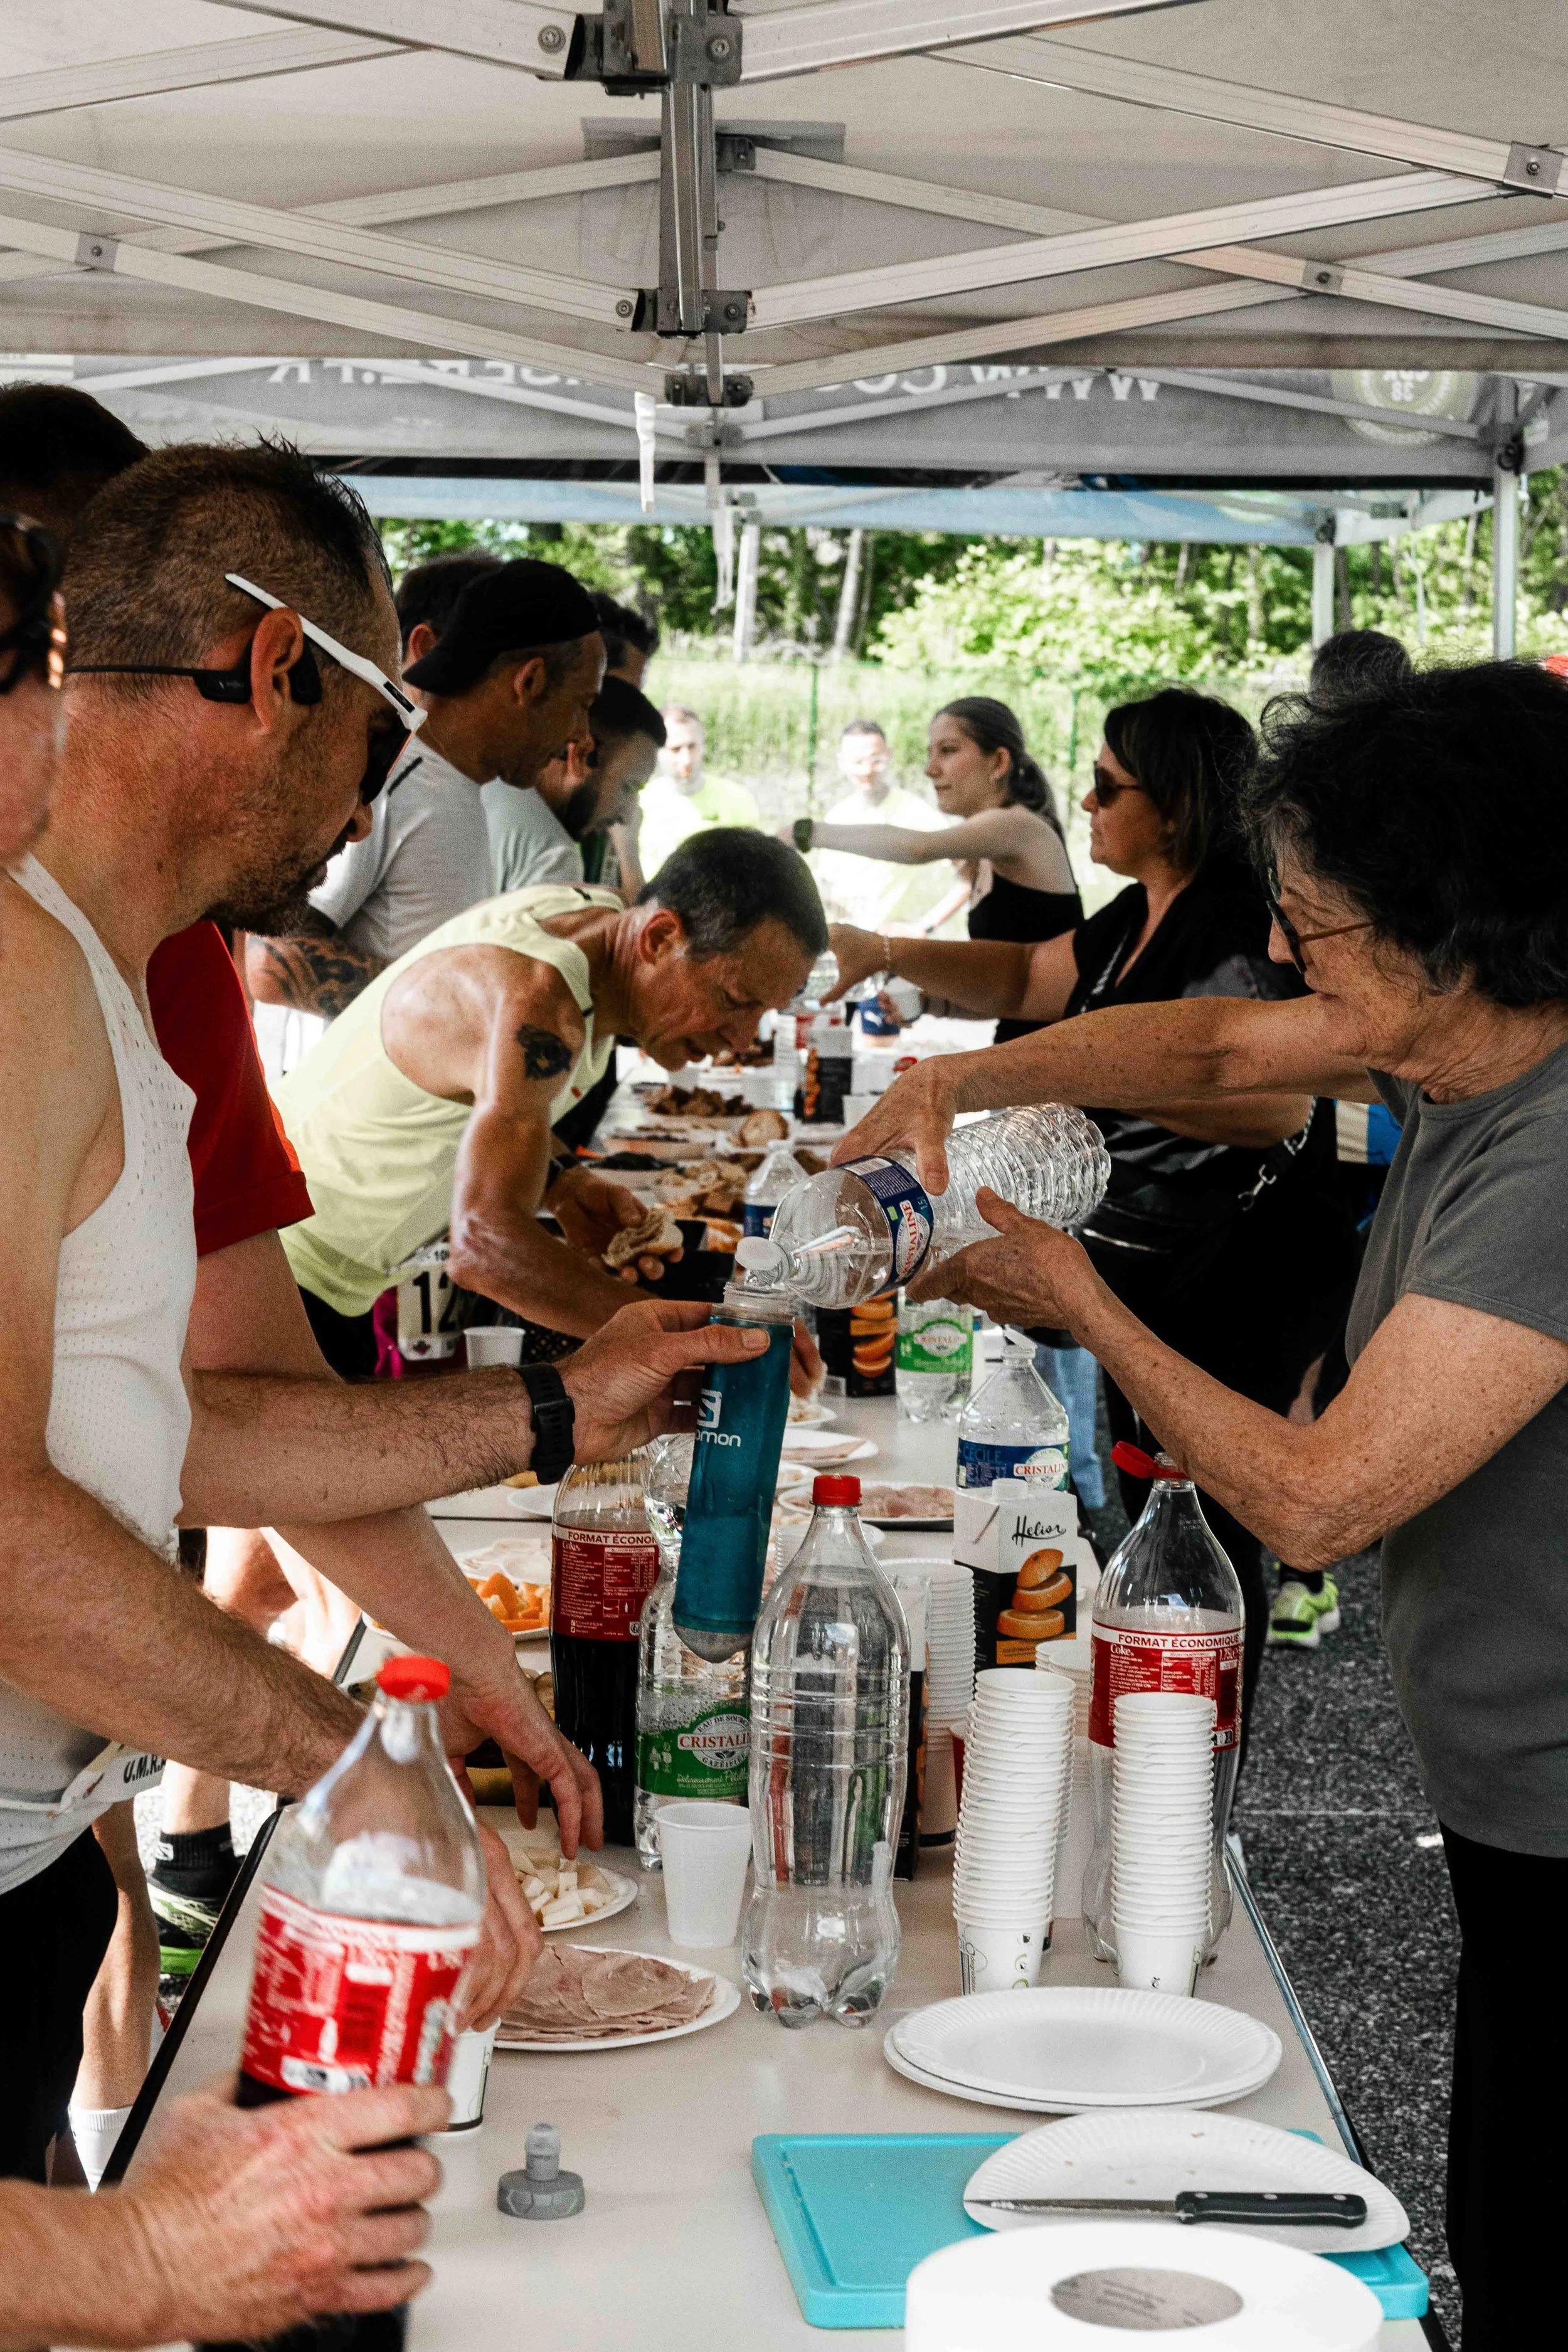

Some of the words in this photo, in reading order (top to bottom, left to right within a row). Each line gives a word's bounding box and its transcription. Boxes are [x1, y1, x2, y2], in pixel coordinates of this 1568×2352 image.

[1015, 1463, 1066, 1475] CRISTALIN
[568, 1531, 610, 1544] FORMAT
[1118, 1633, 1165, 1648] FORMAT
[1172, 1633, 1239, 1648] ÉCONOMIQUE
